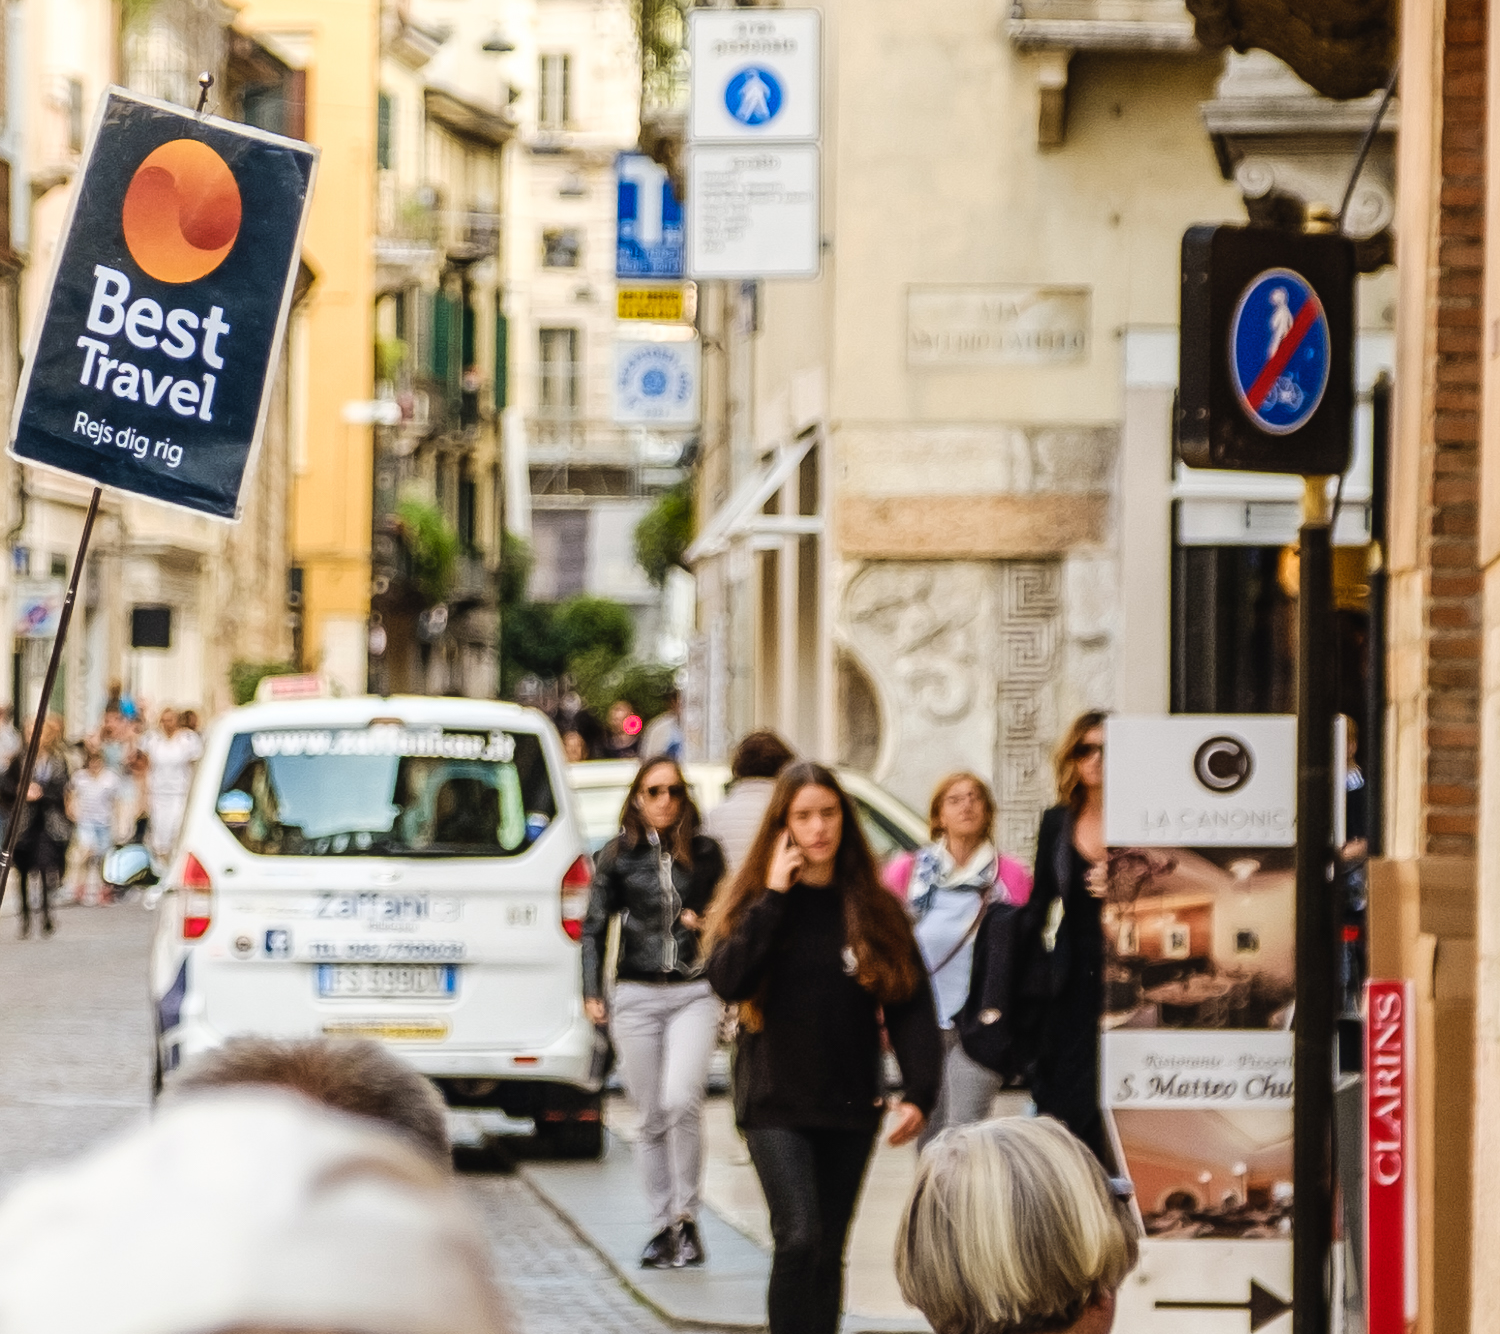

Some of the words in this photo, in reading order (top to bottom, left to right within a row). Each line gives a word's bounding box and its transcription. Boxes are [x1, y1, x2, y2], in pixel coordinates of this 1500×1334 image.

[86, 263, 231, 369] Best
[77, 335, 216, 422] Travel
[73, 411, 114, 445] Rejs
[115, 426, 149, 459] dig
[153, 438, 183, 468] rig
[1180, 809, 1296, 830] CANONIC
[1147, 1071, 1239, 1100] Matteo
[1374, 991, 1402, 1187] CLARINS
